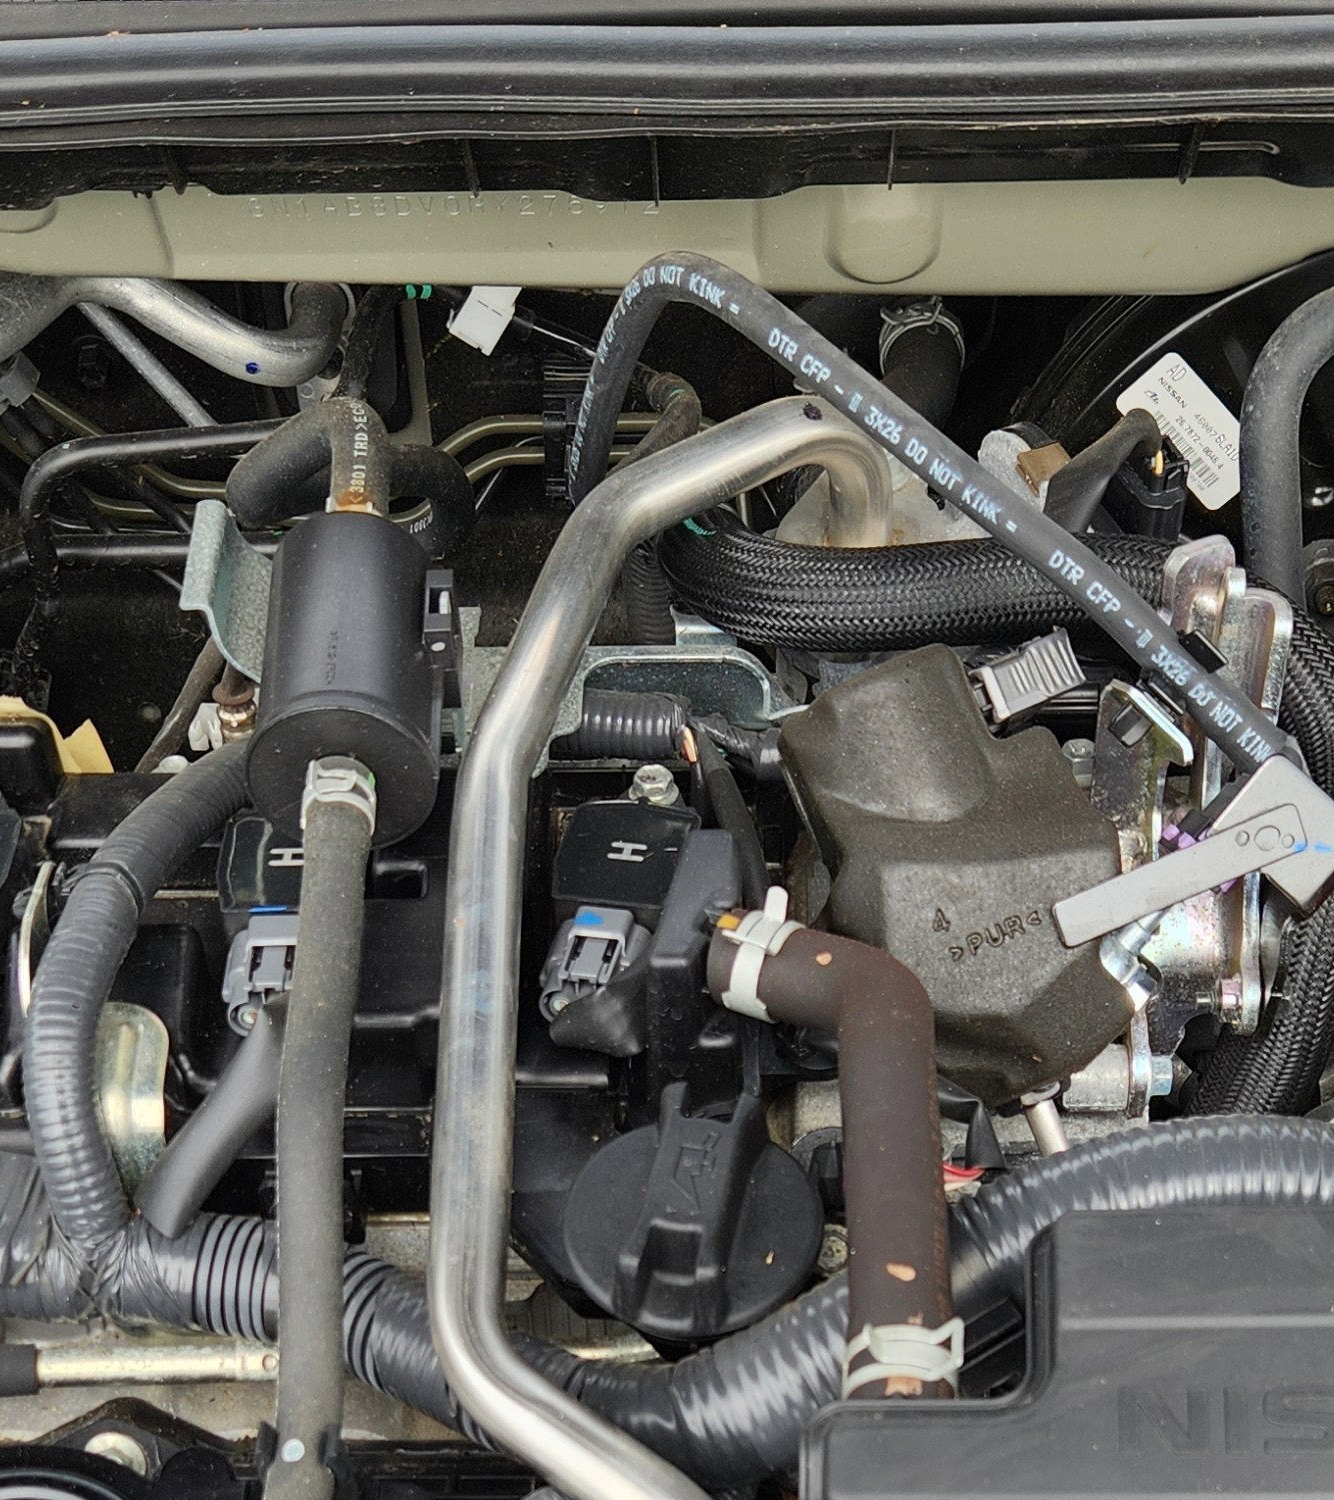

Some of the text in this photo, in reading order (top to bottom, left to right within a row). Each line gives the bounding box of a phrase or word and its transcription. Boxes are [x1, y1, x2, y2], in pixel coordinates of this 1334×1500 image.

[660, 265, 685, 288] NOT
[688, 272, 726, 309] KINK
[1166, 363, 1187, 382] AD
[1158, 377, 1188, 409] NISSAN
[800, 354, 831, 382] CFP
[904, 437, 928, 465] DO
[929, 460, 962, 490] NOT
[961, 484, 1002, 525] KINK
[1048, 550, 1085, 586] DTR
[1086, 581, 1121, 613] CFP
[1188, 681, 1214, 707] DO
[1209, 700, 1244, 732] NOT
[932, 908, 951, 932] 4
